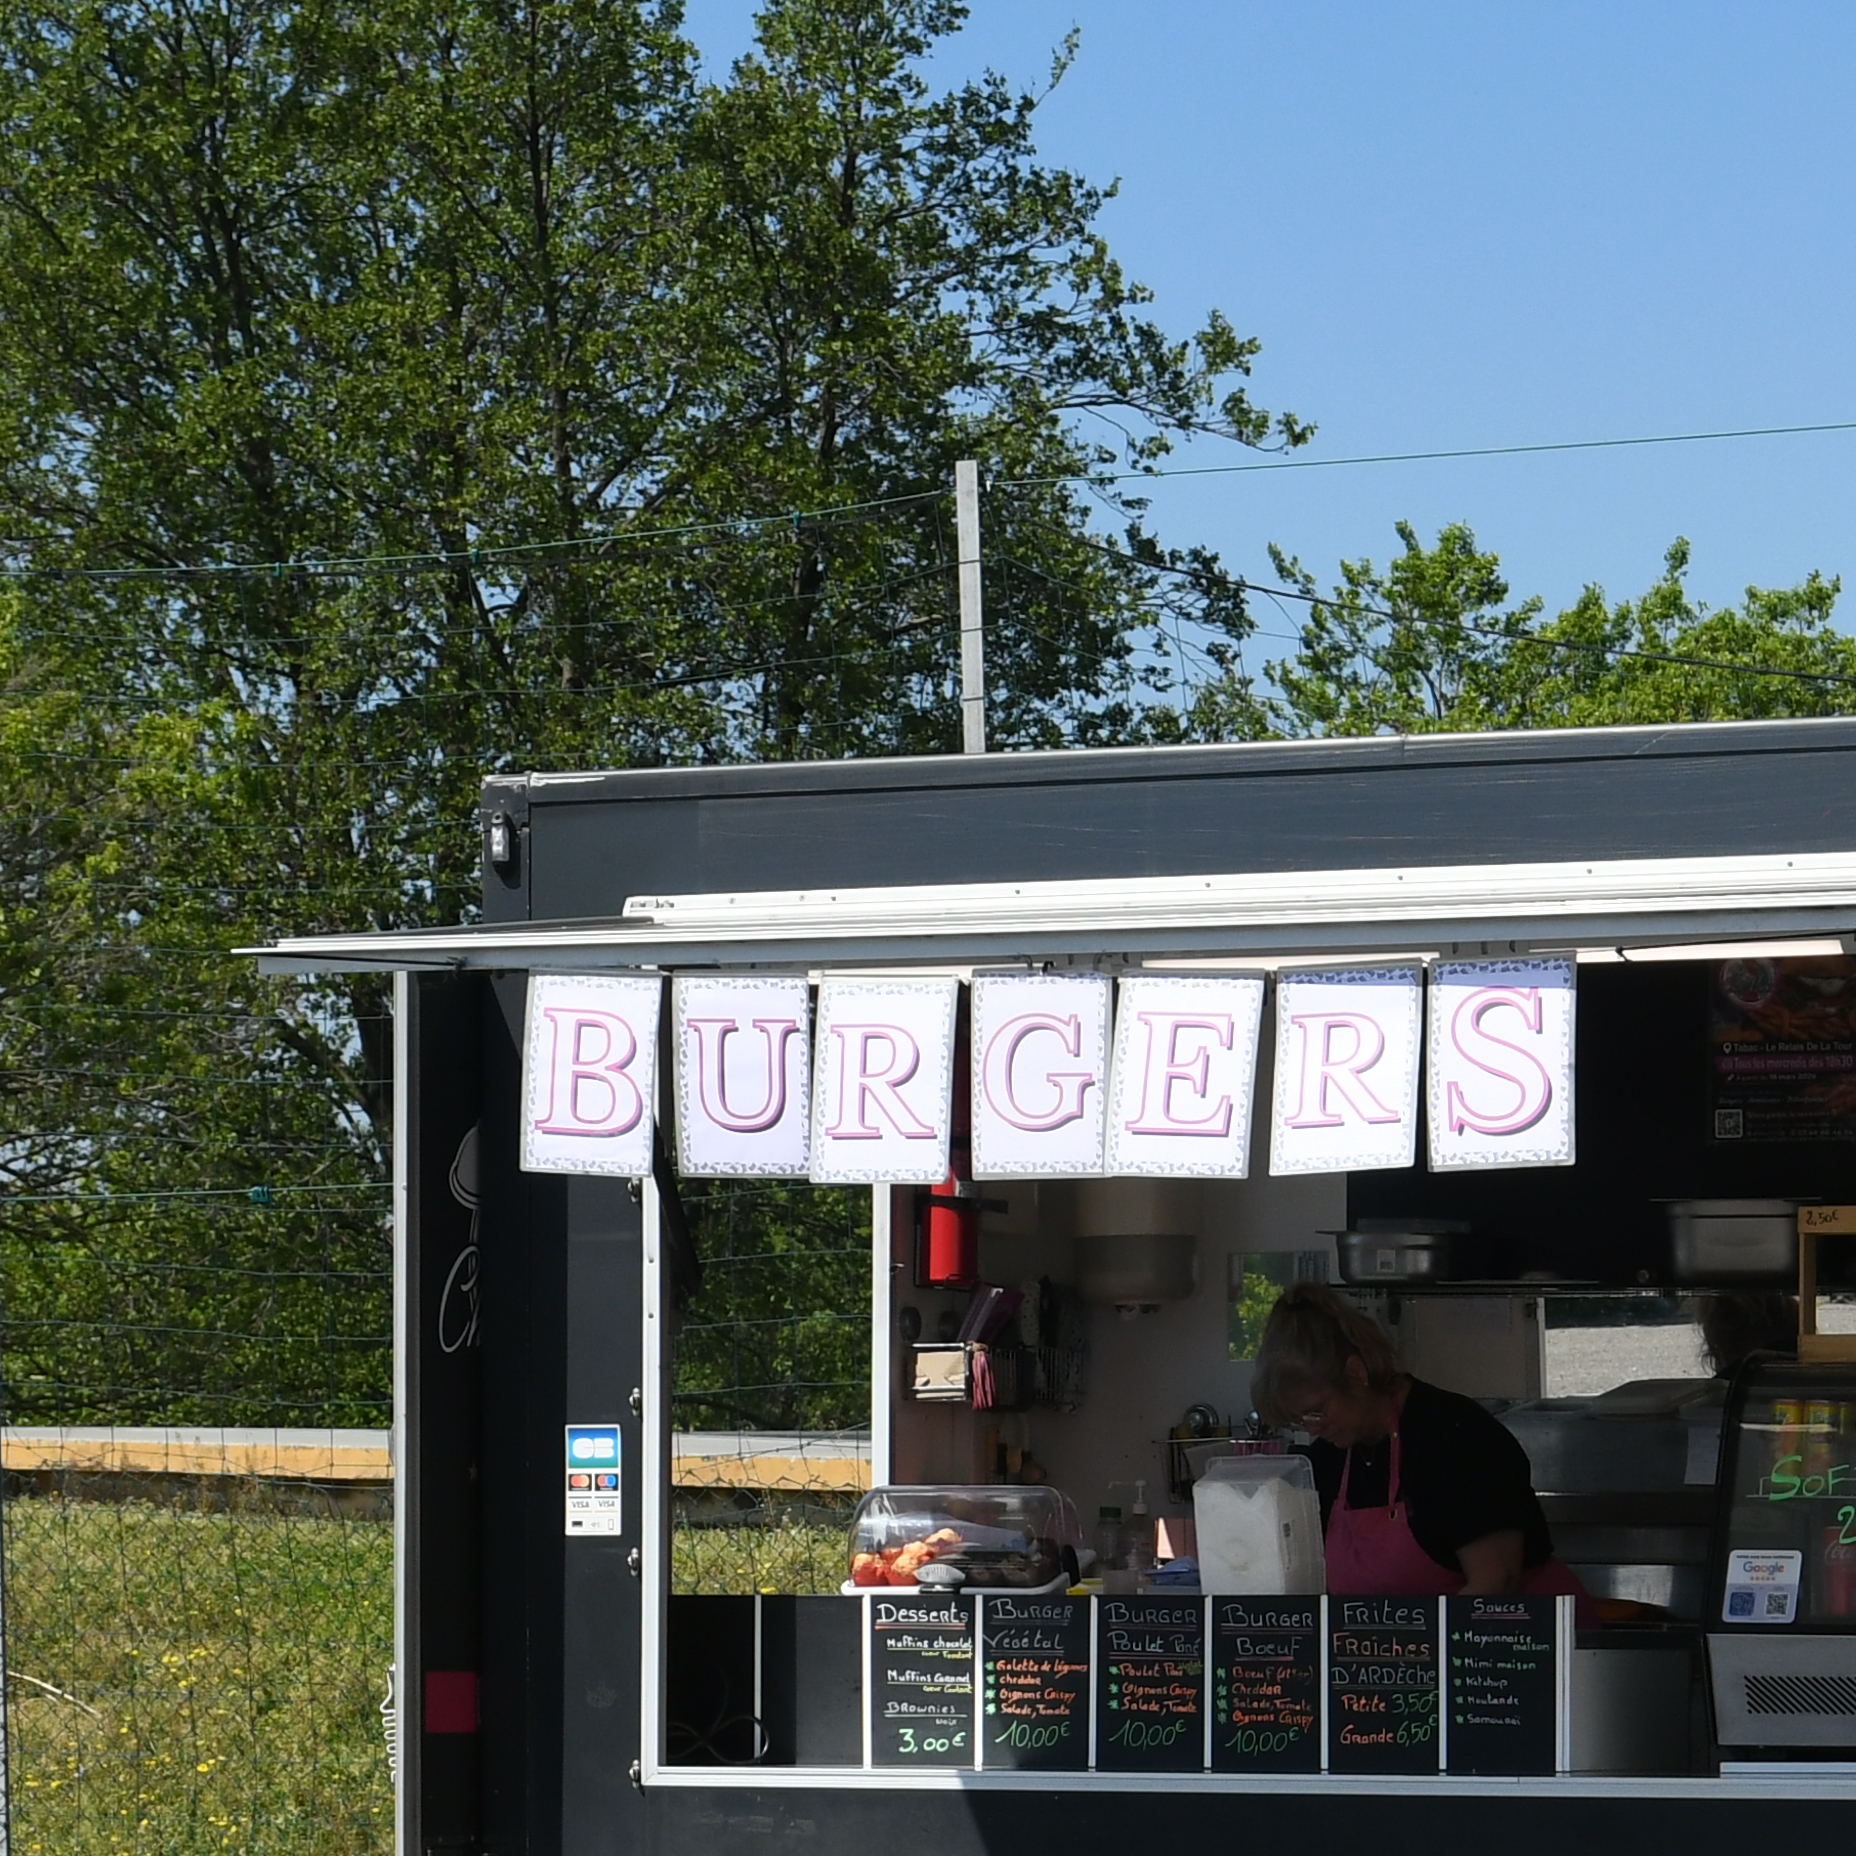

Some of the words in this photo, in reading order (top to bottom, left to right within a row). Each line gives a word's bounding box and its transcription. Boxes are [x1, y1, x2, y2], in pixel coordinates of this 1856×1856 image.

[1734, 1042, 1758, 1052] Tabac
[1766, 1043, 1777, 1052] Le
[1833, 1041, 1853, 1051] Tour
[533, 985, 1554, 1140] BURGERS
[571, 1437, 615, 1459] CB
[572, 1500, 591, 1509] VISA
[598, 1499, 616, 1508] VISA
[1743, 1560, 1785, 1576] Google
[1472, 1597, 1526, 1614] Sauces
[1106, 1630, 1165, 1653] Poulet
[887, 1668, 932, 1683] Muffins
[1118, 1662, 1160, 1678] Poulet
[1340, 1693, 1387, 1713] Petite
[898, 1727, 967, 1754] 3,00€
[994, 1719, 1071, 1750] 10,00€
[1108, 1718, 1187, 1752] 10,00€
[1224, 1726, 1300, 1757] 10,00€
